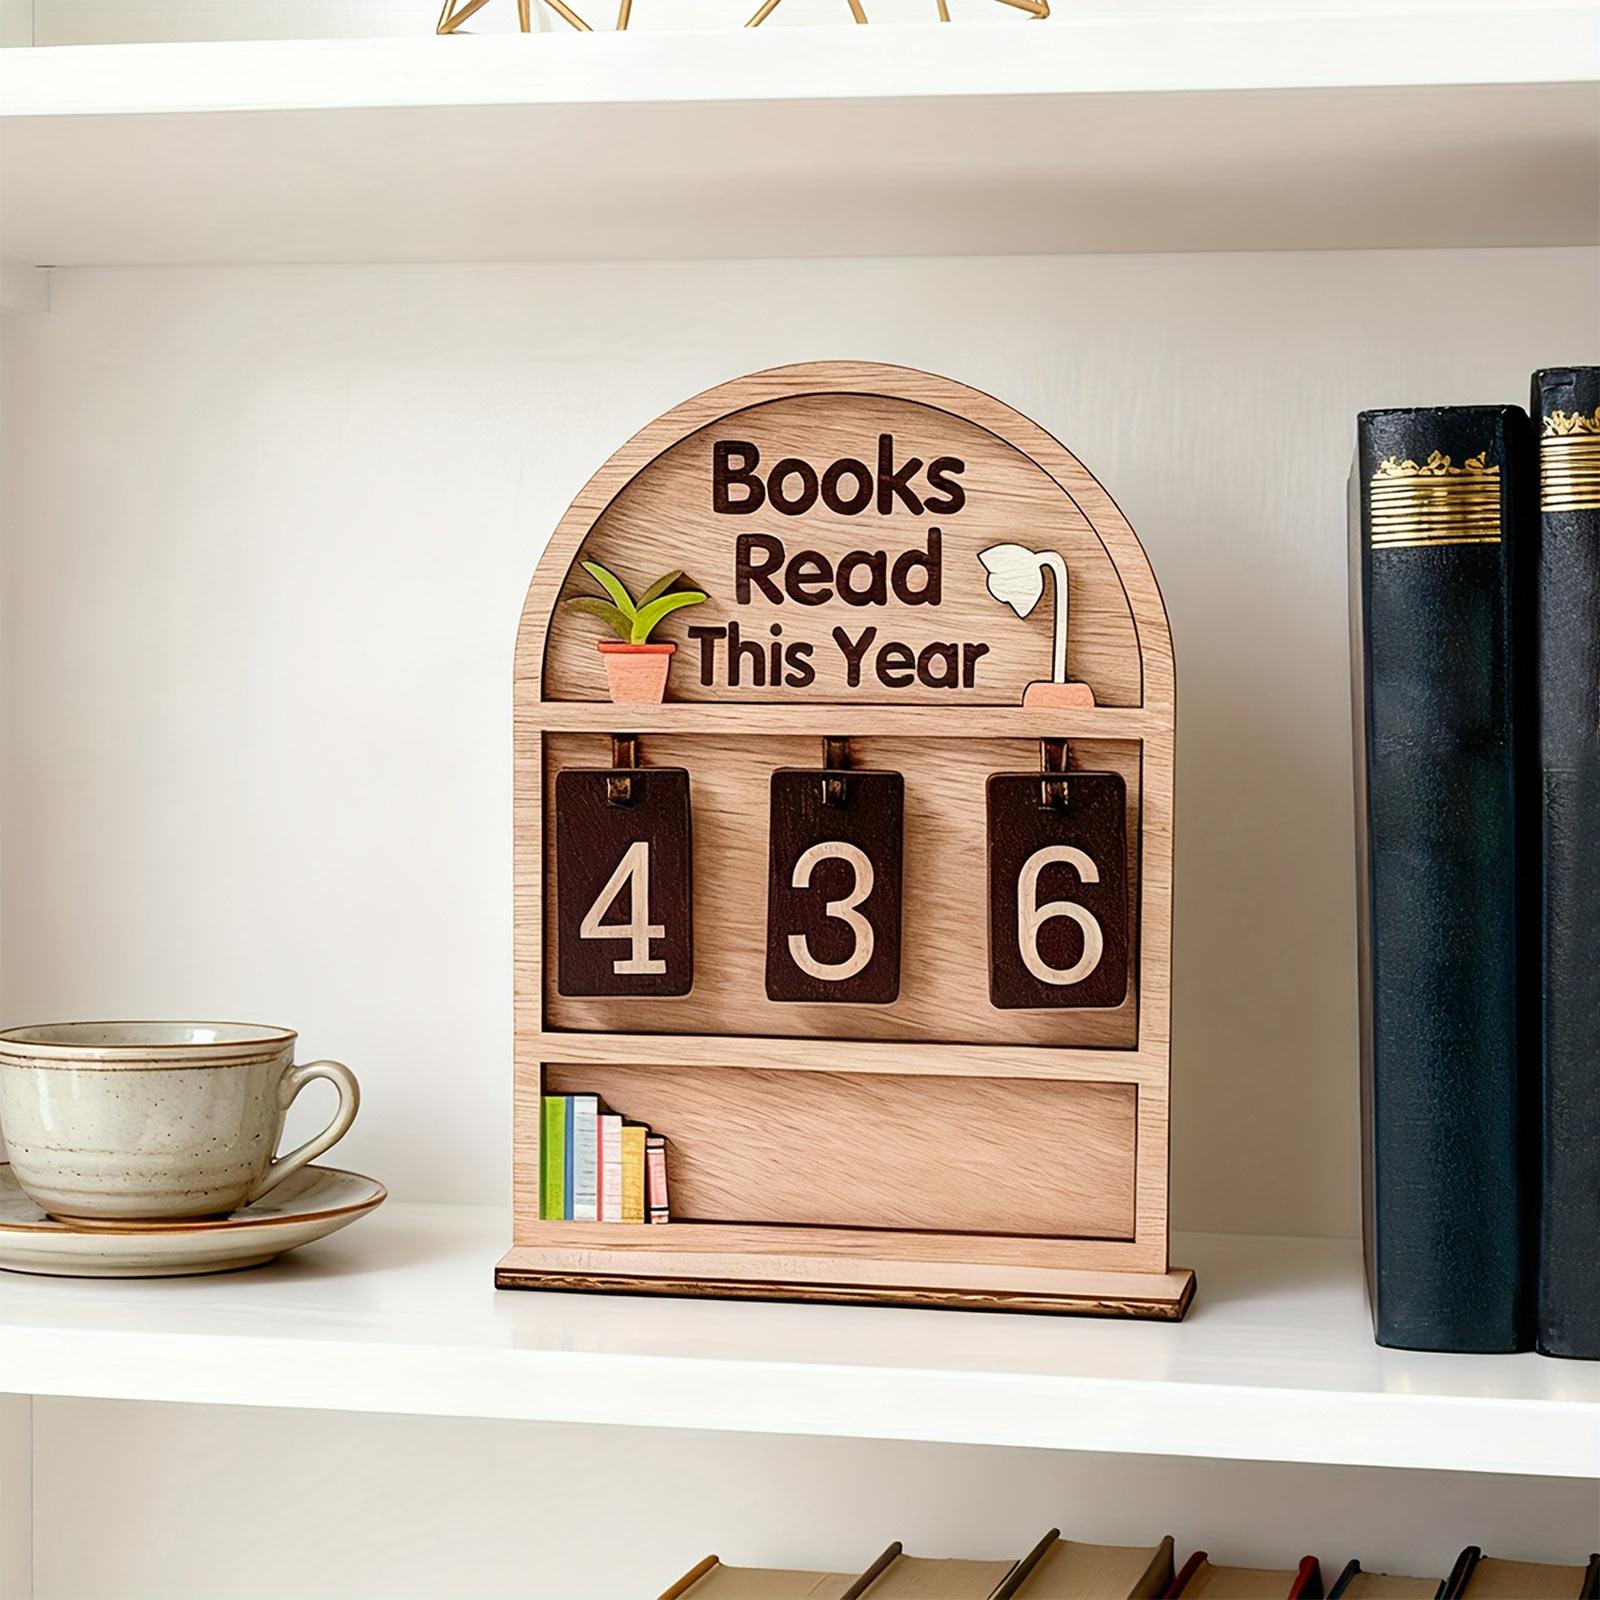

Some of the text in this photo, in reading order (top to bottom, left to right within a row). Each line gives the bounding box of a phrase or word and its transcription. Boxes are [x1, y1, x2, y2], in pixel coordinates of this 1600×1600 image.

[713, 434, 965, 515] Books
[736, 527, 942, 606] Read
[688, 621, 989, 688] This Year
[579, 841, 1104, 985] 4 3 6
